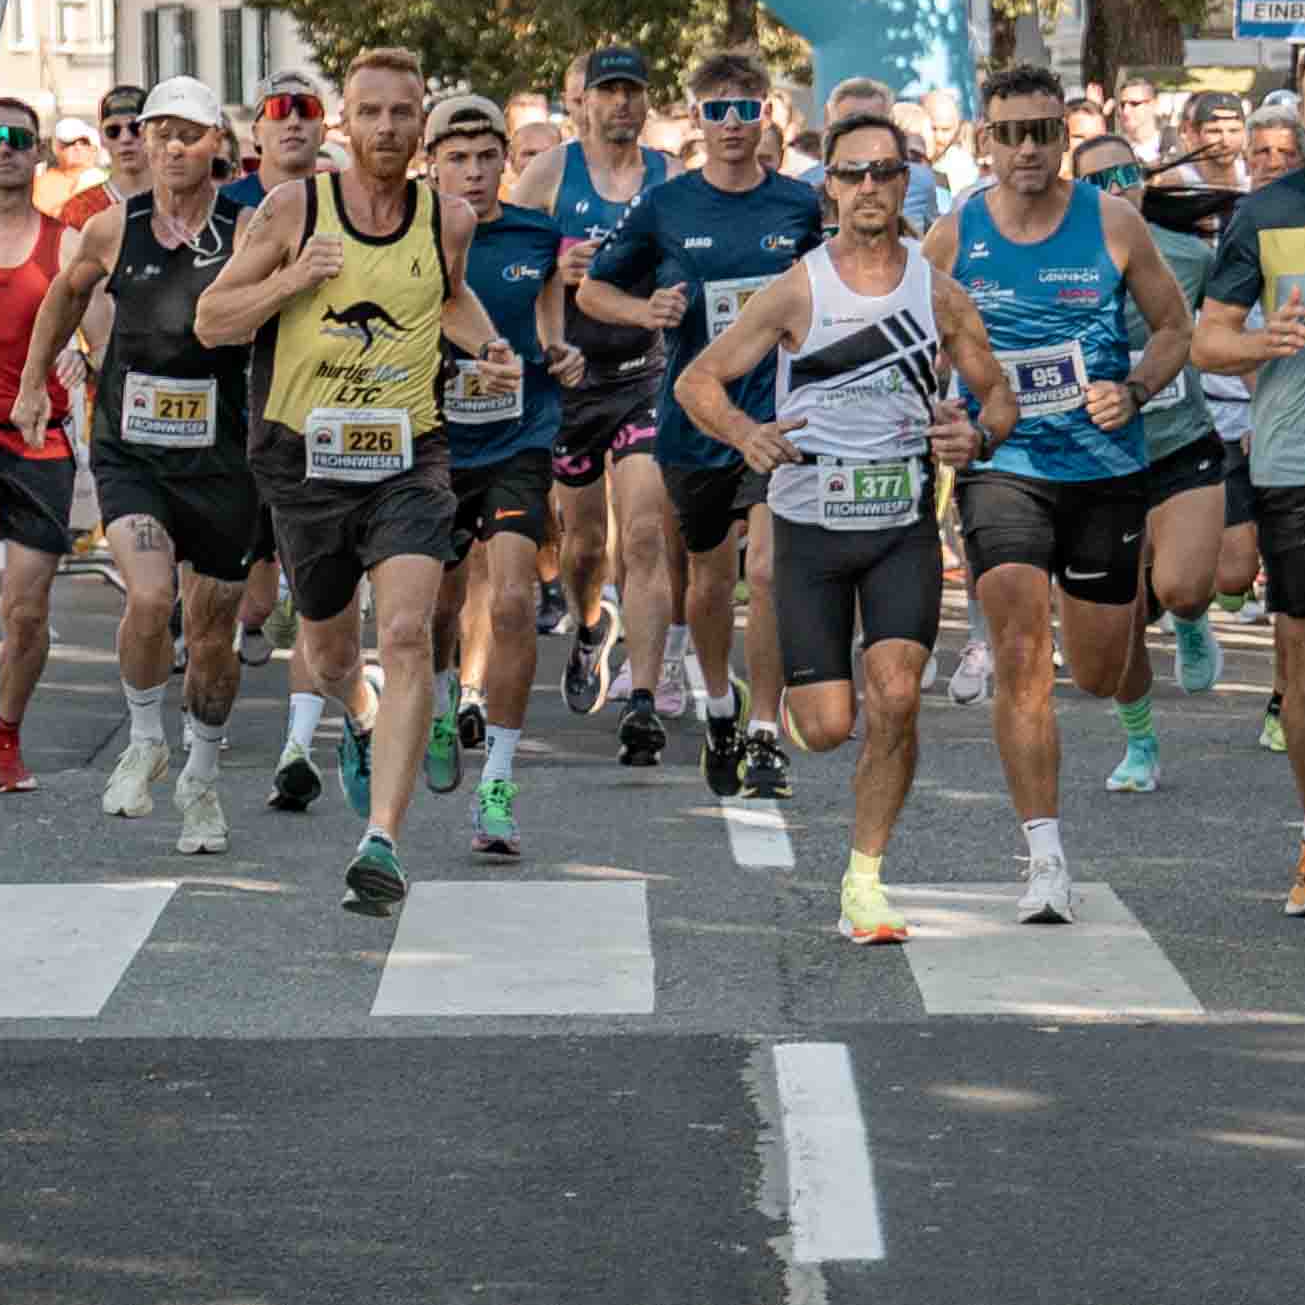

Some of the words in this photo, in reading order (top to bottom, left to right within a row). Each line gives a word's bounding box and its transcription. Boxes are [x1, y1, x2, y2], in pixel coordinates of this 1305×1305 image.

[1031, 367, 1062, 388] 95
[335, 385, 382, 403] LTC
[159, 399, 200, 418] 217
[349, 432, 393, 452] 226
[861, 476, 903, 498] 377
